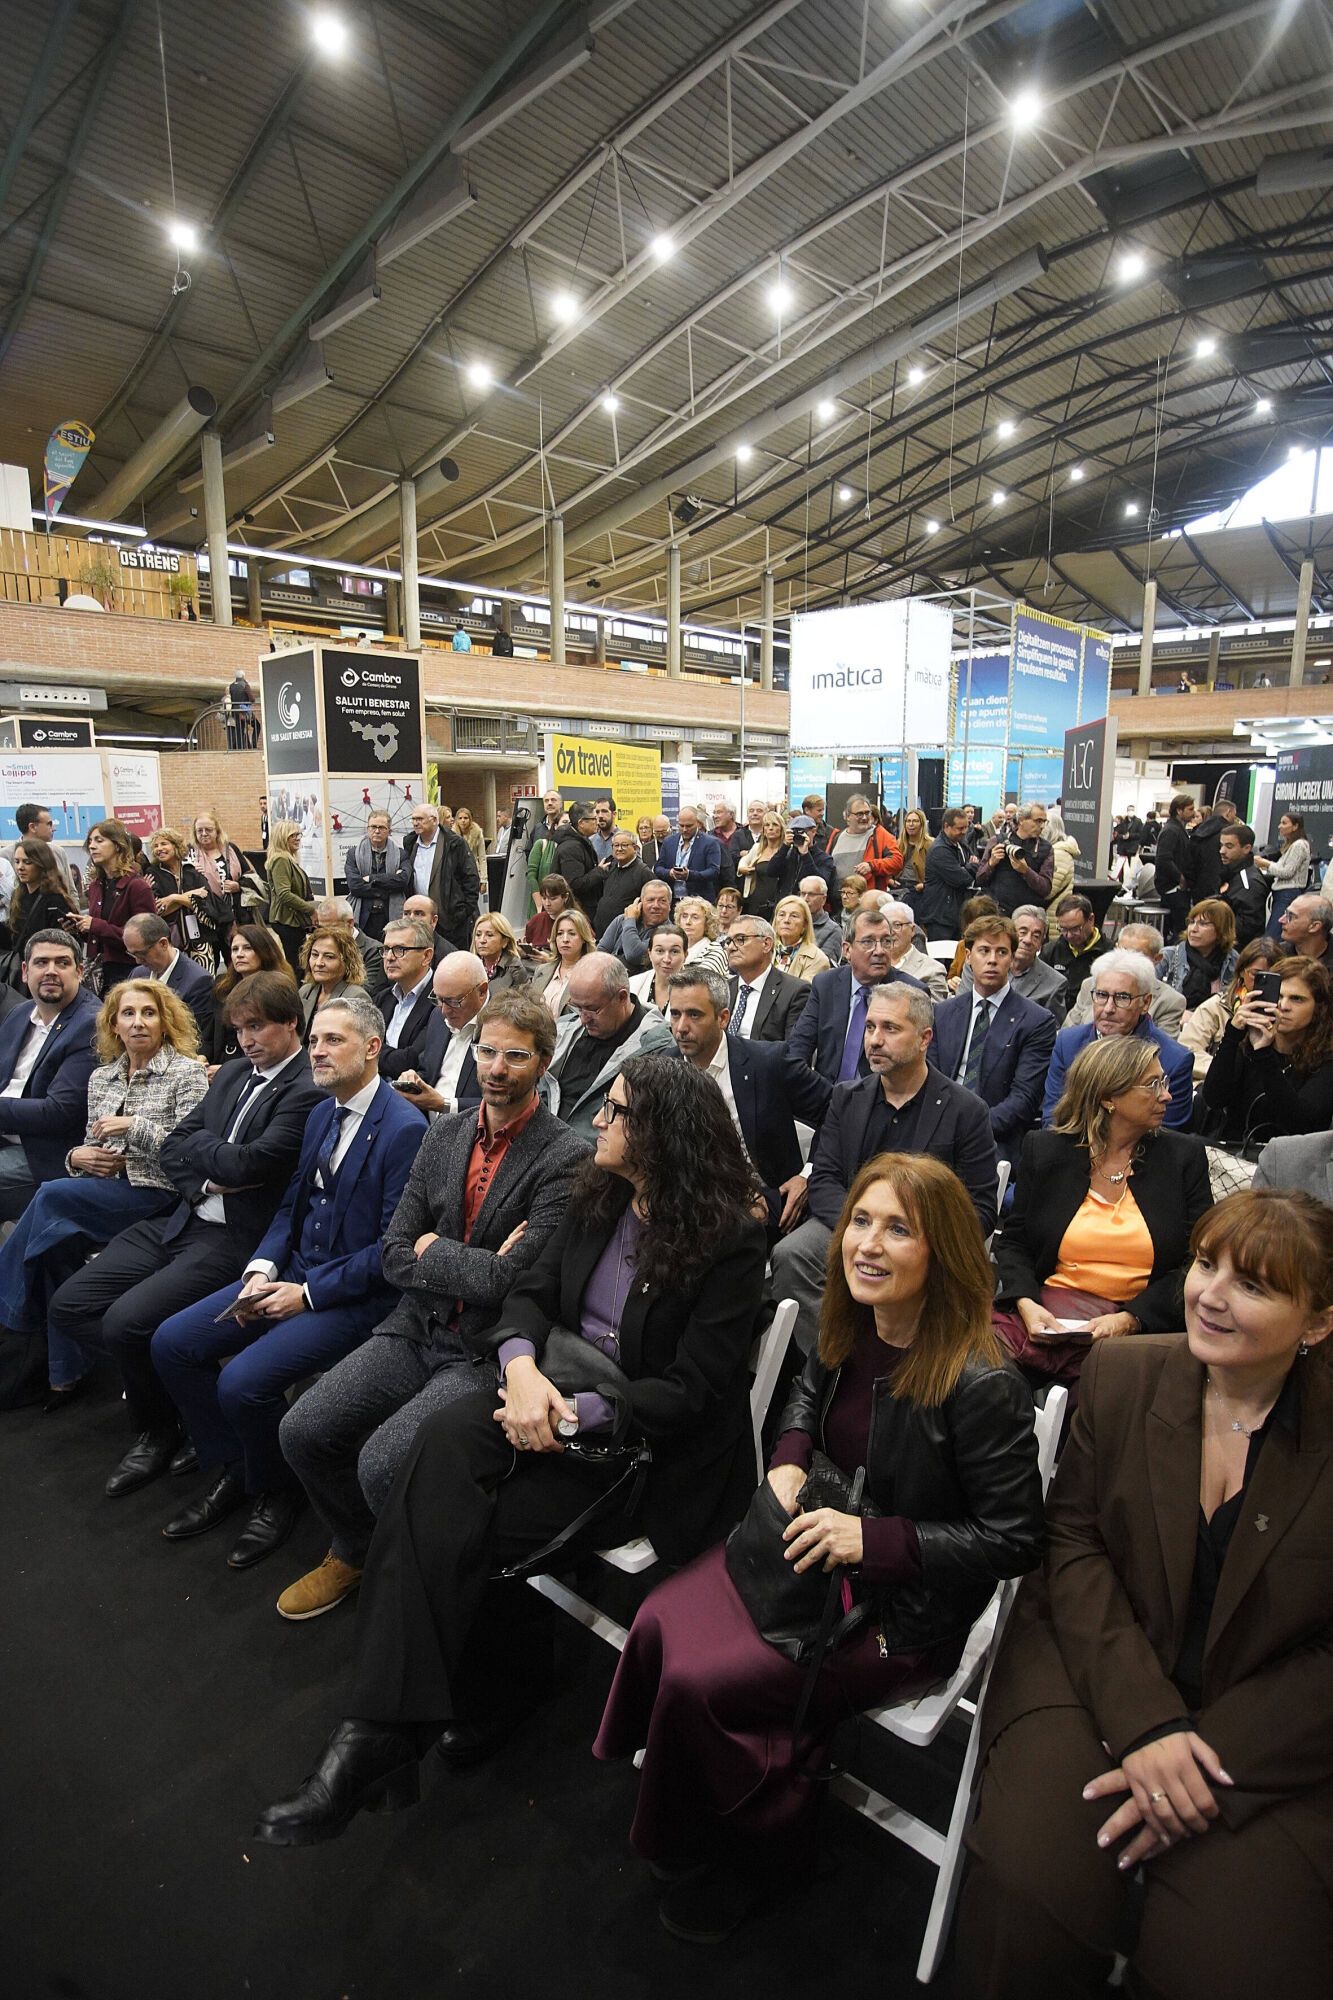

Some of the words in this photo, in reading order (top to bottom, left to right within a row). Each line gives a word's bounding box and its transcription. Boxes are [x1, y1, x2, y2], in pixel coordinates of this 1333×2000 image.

[61, 431, 90, 446] ESTIU
[120, 551, 179, 571] OSTRENS
[1018, 630, 1051, 650] Digitalitzem
[1017, 644, 1053, 665] Simplifiquem
[1016, 659, 1044, 676] Impulsem
[361, 671, 402, 684] Cambra
[335, 696, 363, 706] SALUT
[369, 698, 410, 710] BENESTAR
[986, 695, 1008, 705] diem
[973, 719, 994, 728] diem
[280, 732, 292, 741] SALUT
[292, 730, 313, 740] BENESTAR
[578, 746, 612, 777] travel
[2, 769, 37, 777] Lollipop
[1275, 782, 1297, 801] GIRONA
[1297, 780, 1321, 801] MEREIX
